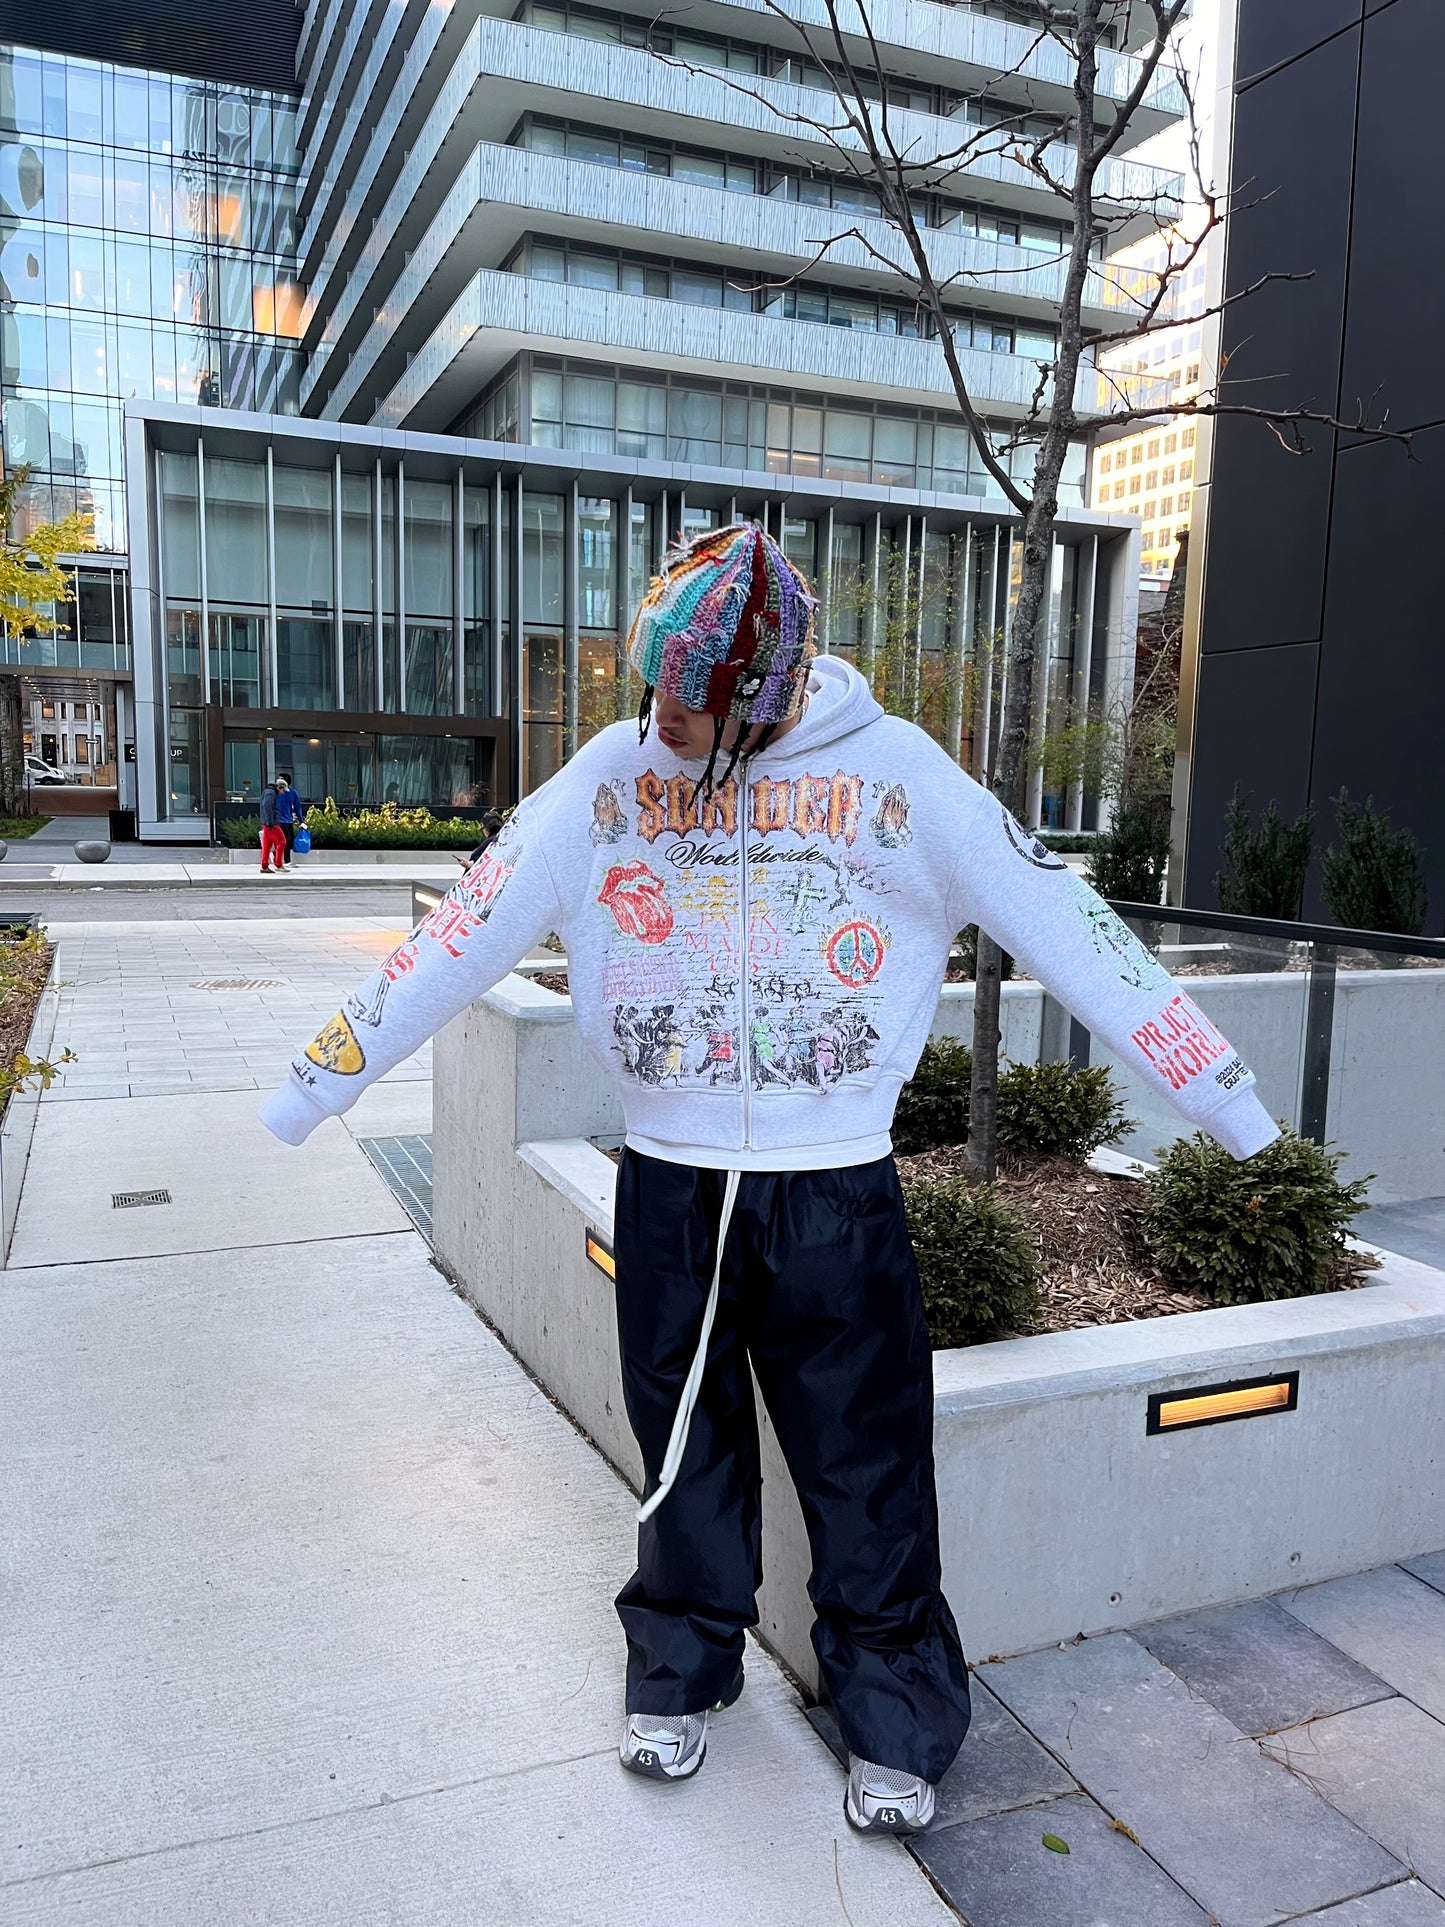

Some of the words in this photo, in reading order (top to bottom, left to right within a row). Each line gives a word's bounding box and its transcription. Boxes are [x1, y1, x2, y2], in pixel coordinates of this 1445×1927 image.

[1131, 991, 1205, 1062] PRJCT
[638, 1750, 653, 1766] 43
[881, 1810, 897, 1824] 43
